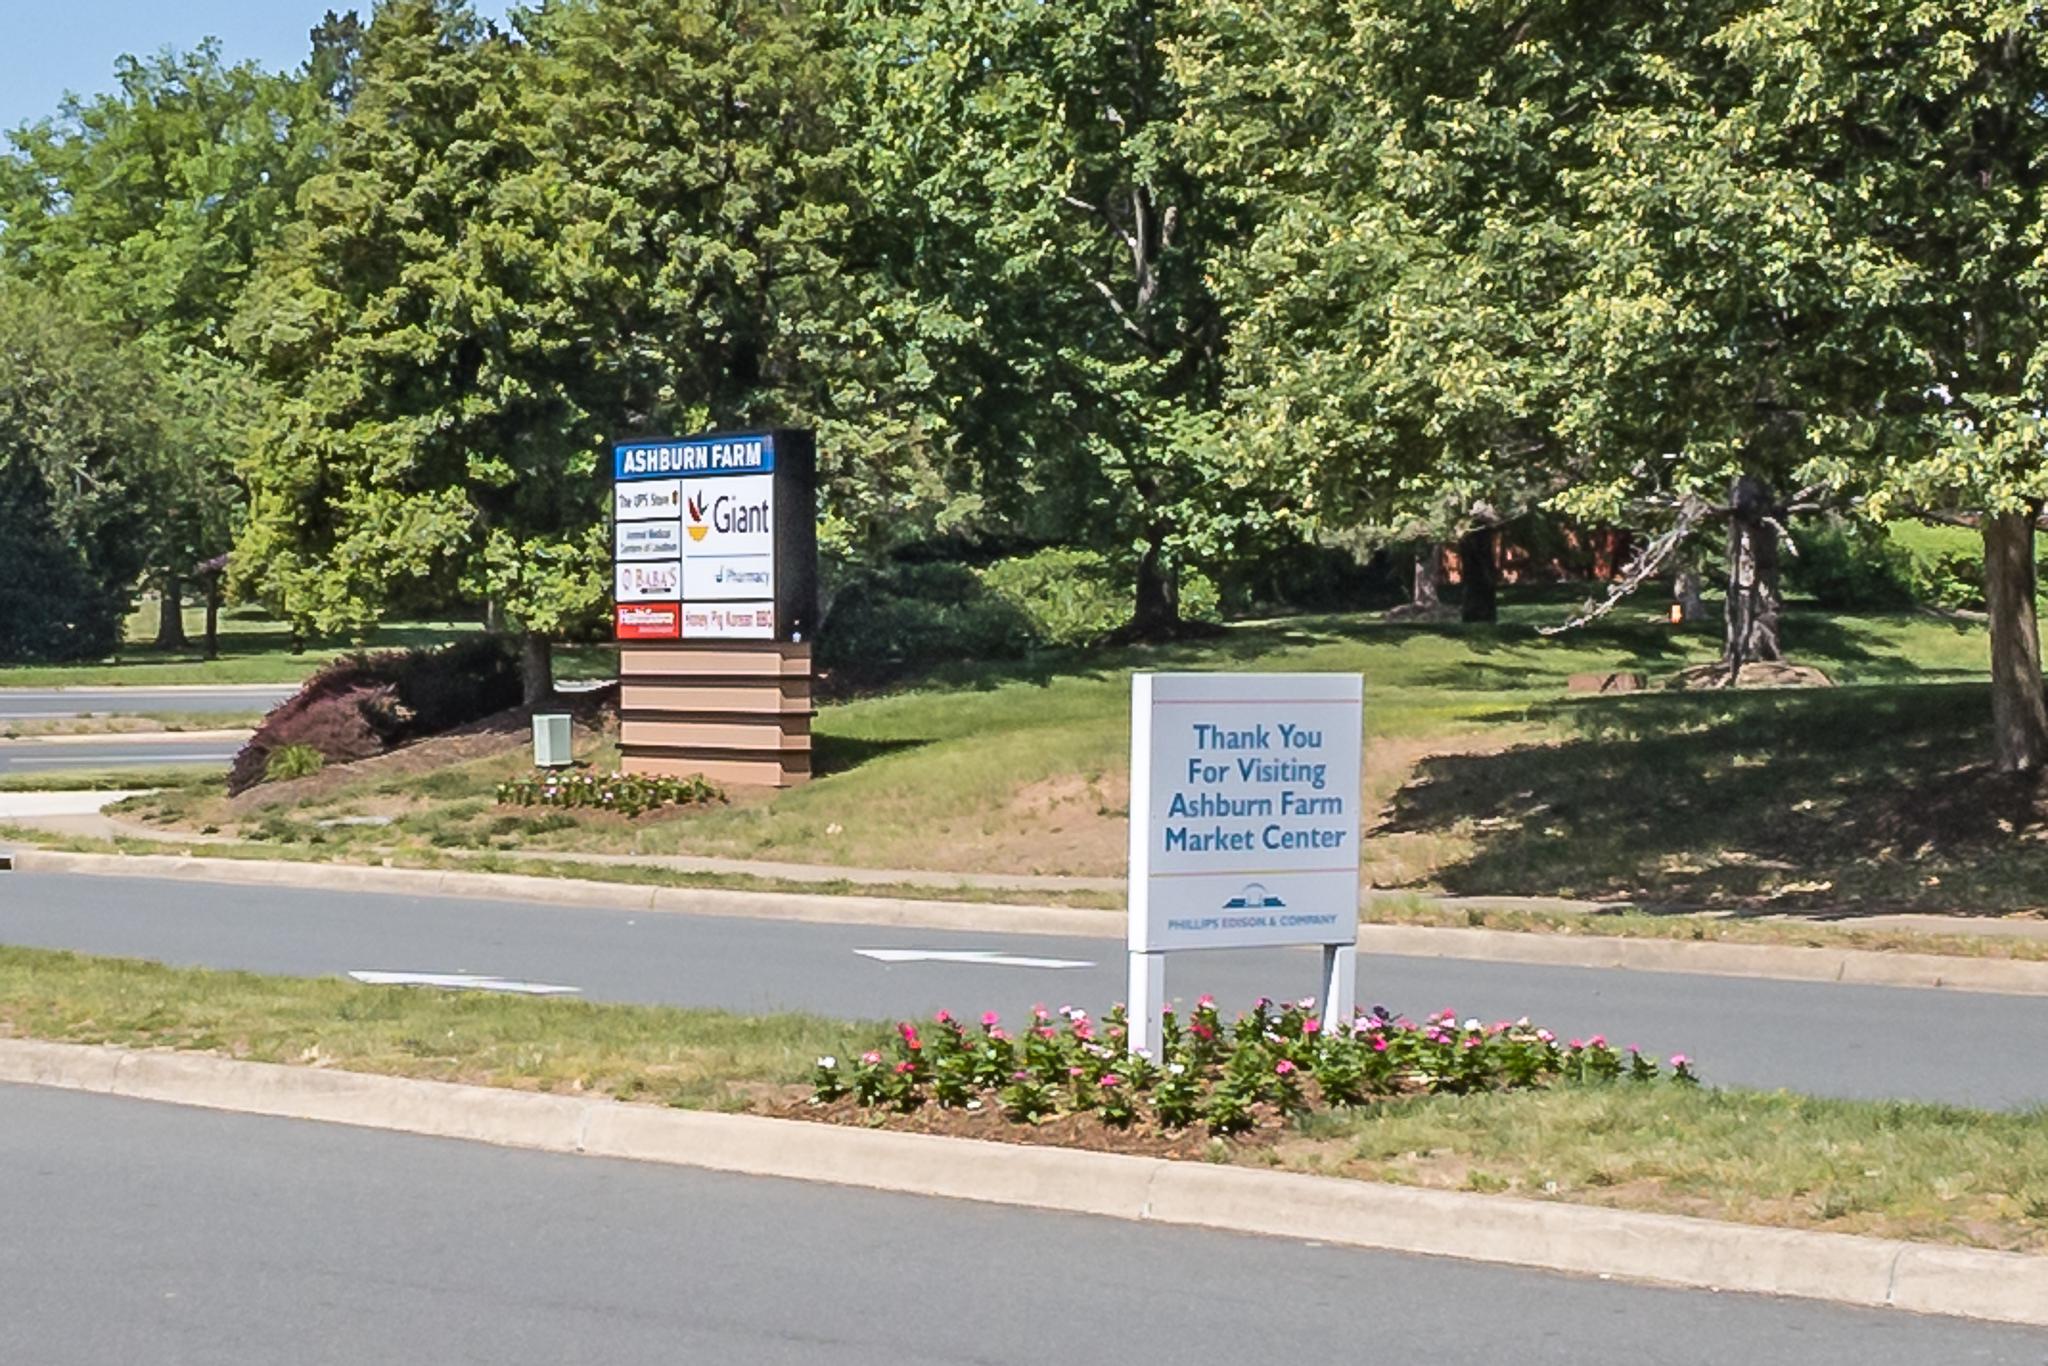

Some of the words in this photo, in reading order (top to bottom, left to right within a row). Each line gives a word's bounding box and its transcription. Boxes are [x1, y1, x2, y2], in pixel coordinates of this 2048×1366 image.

[624, 447, 707, 473] ASHBURN
[712, 442, 761, 468] FARM
[619, 493, 632, 508] The
[714, 496, 769, 534] Giant
[1193, 724, 1270, 750] Thank
[1277, 724, 1322, 749] You
[1188, 758, 1230, 784] For
[1237, 757, 1326, 789] Visiting
[1168, 792, 1272, 818] Ashburn
[1281, 791, 1342, 816] Farm
[1165, 826, 1254, 852] Market
[1262, 825, 1347, 849] Center
[1168, 918, 1218, 930] PHILLIPS
[1221, 916, 1266, 928] EDISON
[1279, 914, 1338, 926] COMPANY
